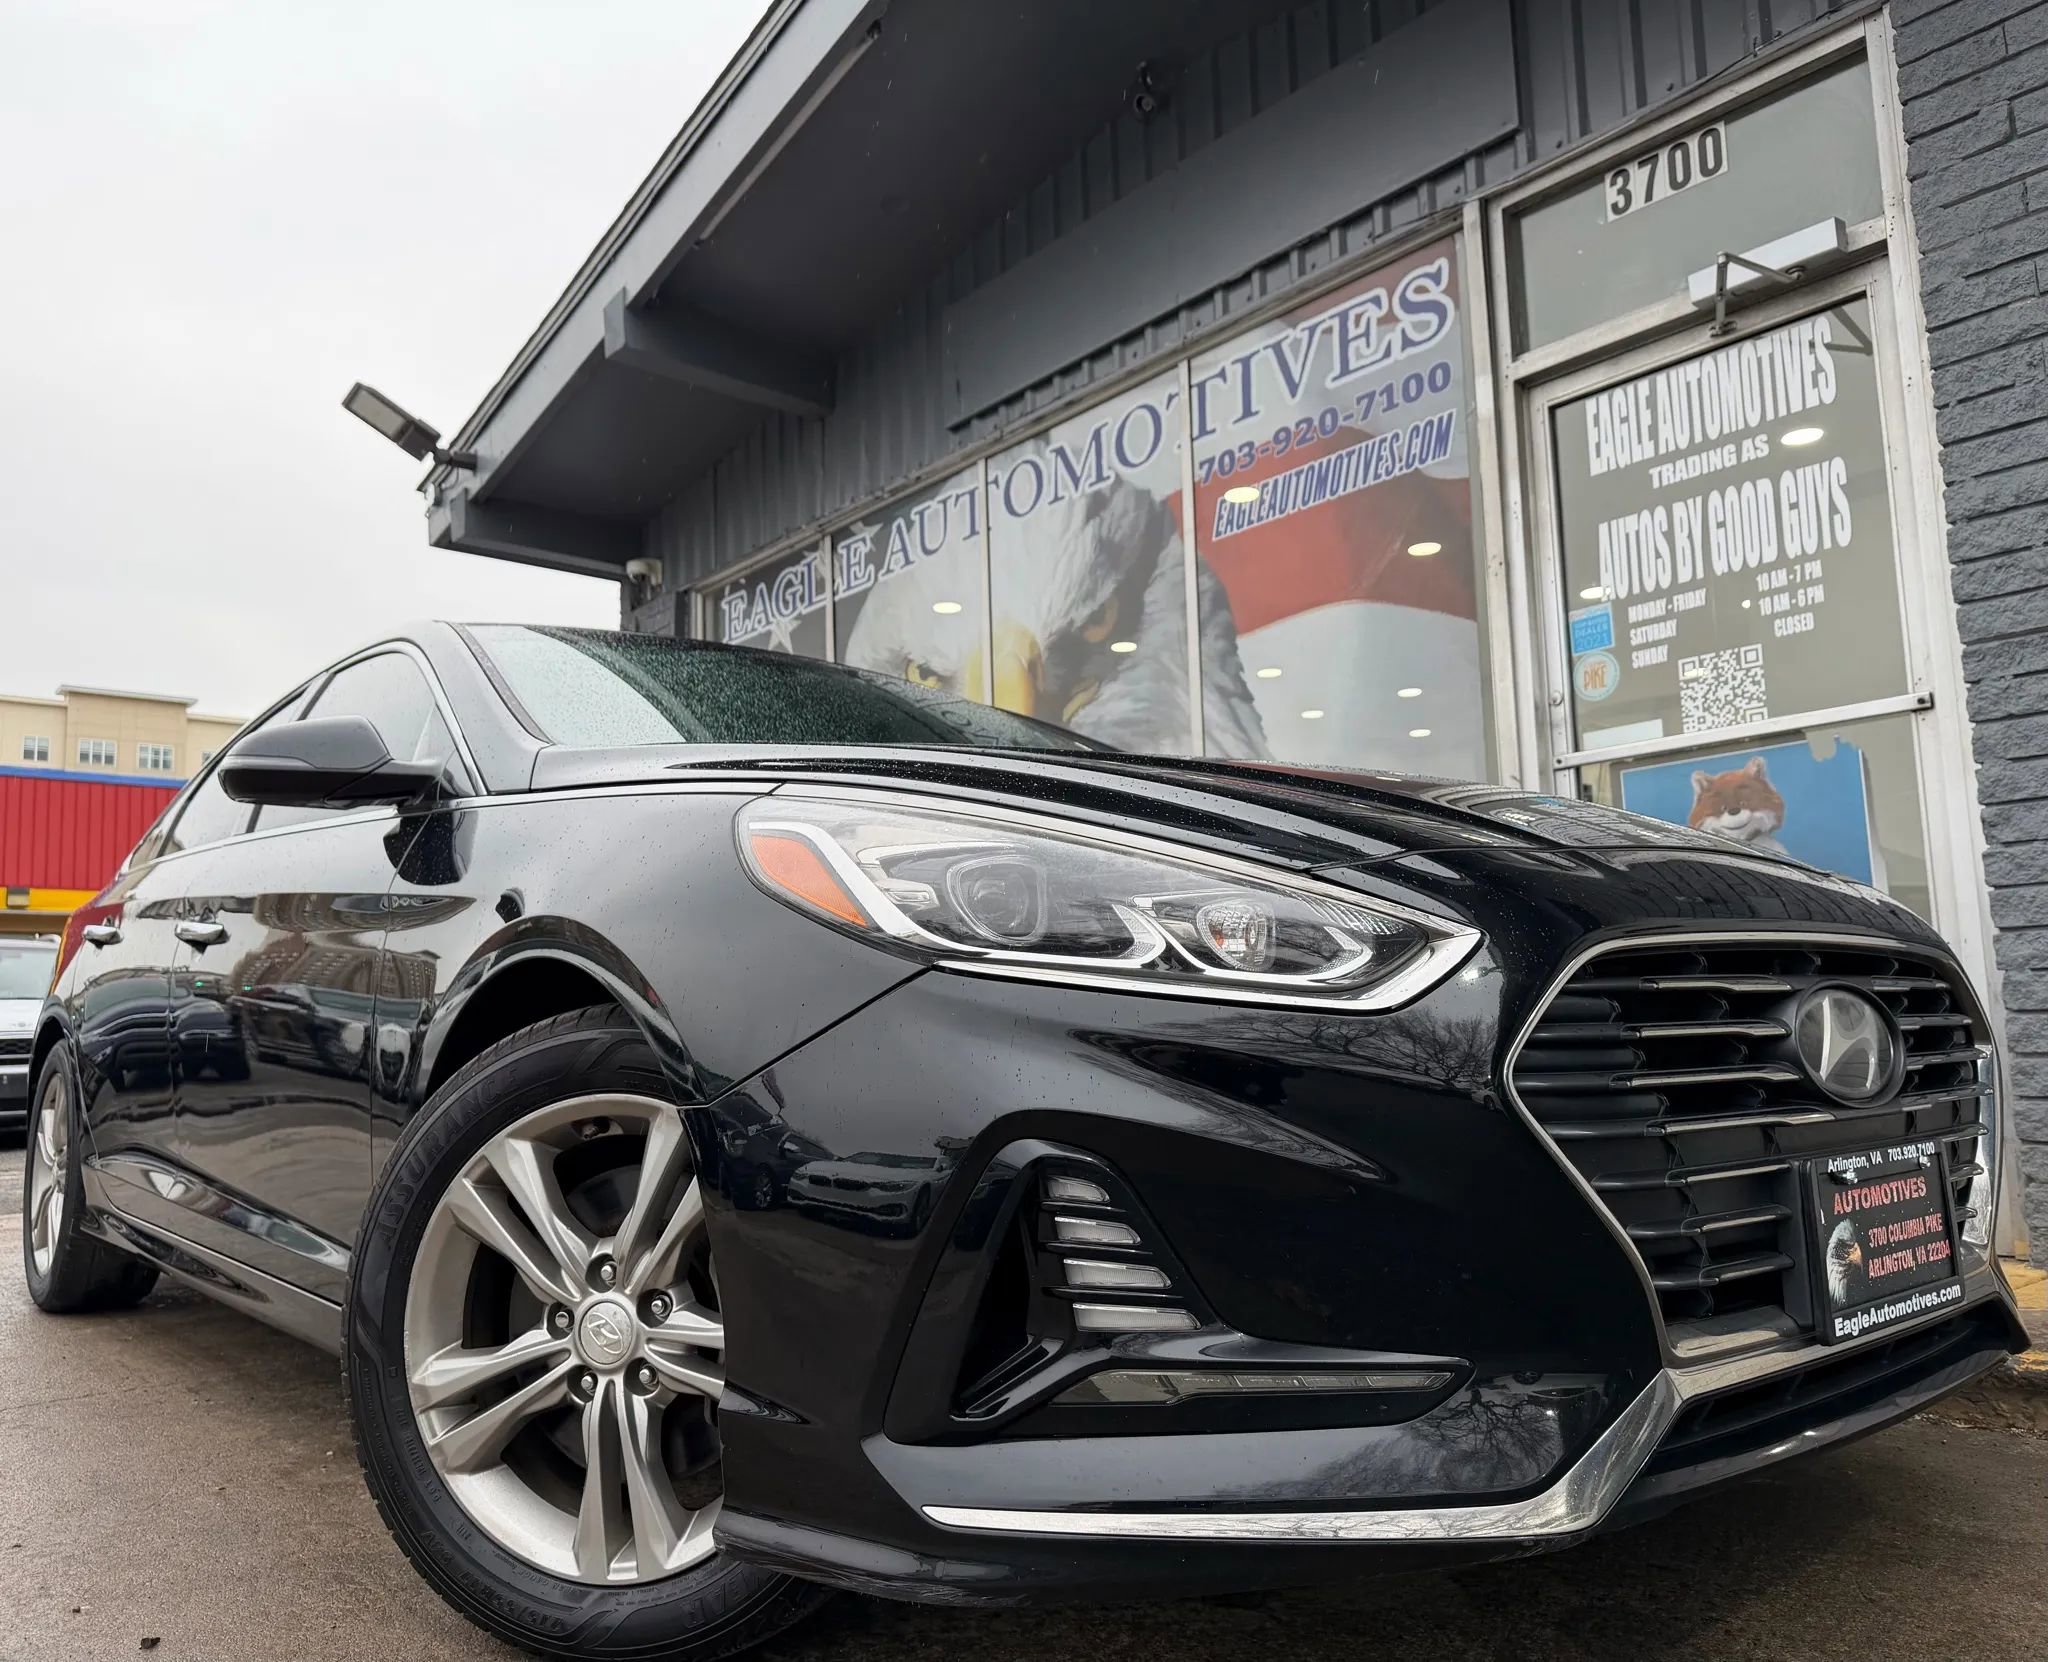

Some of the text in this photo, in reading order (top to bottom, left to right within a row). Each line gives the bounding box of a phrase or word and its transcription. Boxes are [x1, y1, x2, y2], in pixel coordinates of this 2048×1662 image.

[1609, 127, 1724, 216] 3700
[1585, 316, 1838, 477] EAGLE AUTOMOTIVES
[1199, 361, 1452, 484] 703-920-7100
[1212, 408, 1457, 541] EAGLEAUTOMOTIVES.COM
[1649, 434, 1769, 489] TRADING AS
[1598, 456, 1852, 602] AUTOS BY GOOD GUYS
[721, 534, 876, 644] EAGLE
[1804, 560, 1822, 580] PM
[1628, 598, 1667, 623] MONDAY
[1673, 588, 1707, 613] FRIDAY
[1774, 612, 1814, 637] CLOSED
[1630, 619, 1677, 646] SATURDAY
[1632, 644, 1668, 669] SUNDAY
[1828, 1141, 1935, 1173] Arlington, VA 703.920.7100
[1834, 1175, 1926, 1215] AUTOMOTIVES
[1868, 1213, 1943, 1248] 3700 COLUMBIA PIKE
[1868, 1248, 1916, 1279] ARLINGTON,
[1916, 1246, 1927, 1264] VA
[1834, 1284, 1961, 1337] EagleAutomotives.com
